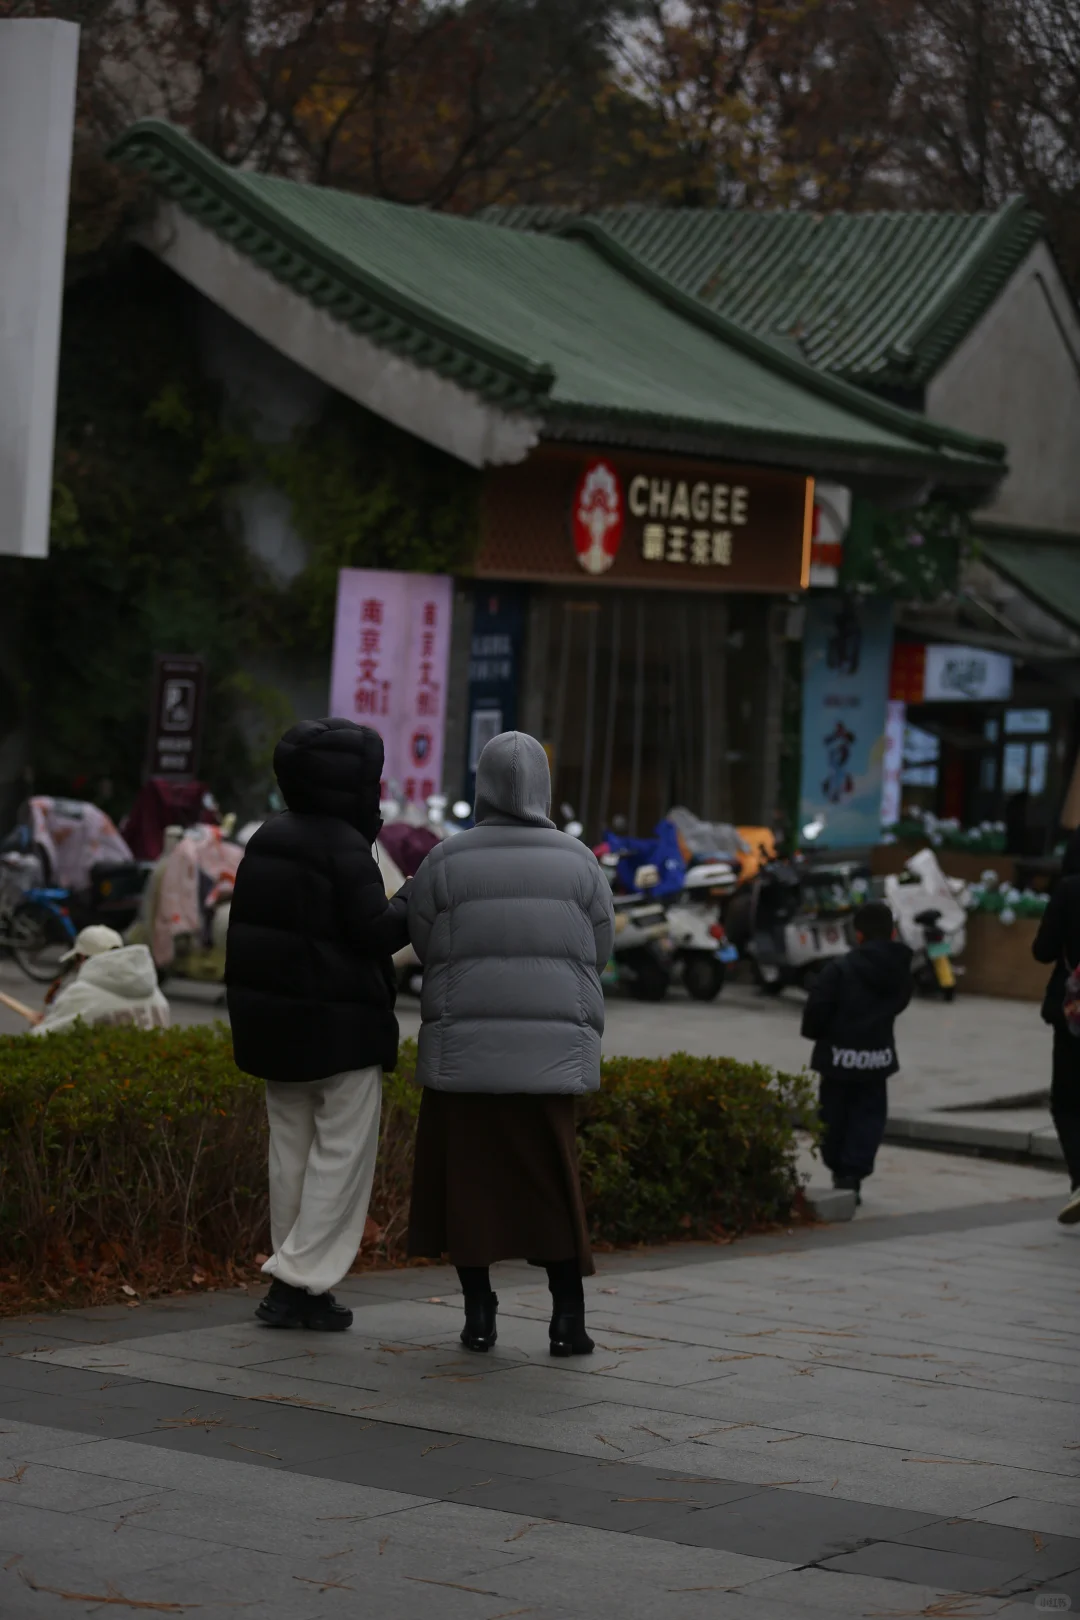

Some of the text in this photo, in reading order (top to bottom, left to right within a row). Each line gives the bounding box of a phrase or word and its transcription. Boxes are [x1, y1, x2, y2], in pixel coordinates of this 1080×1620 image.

[628, 474, 749, 526] CHAGEE
[642, 523, 733, 566] 霸王茶姬
[355, 599, 384, 714] 南京文创
